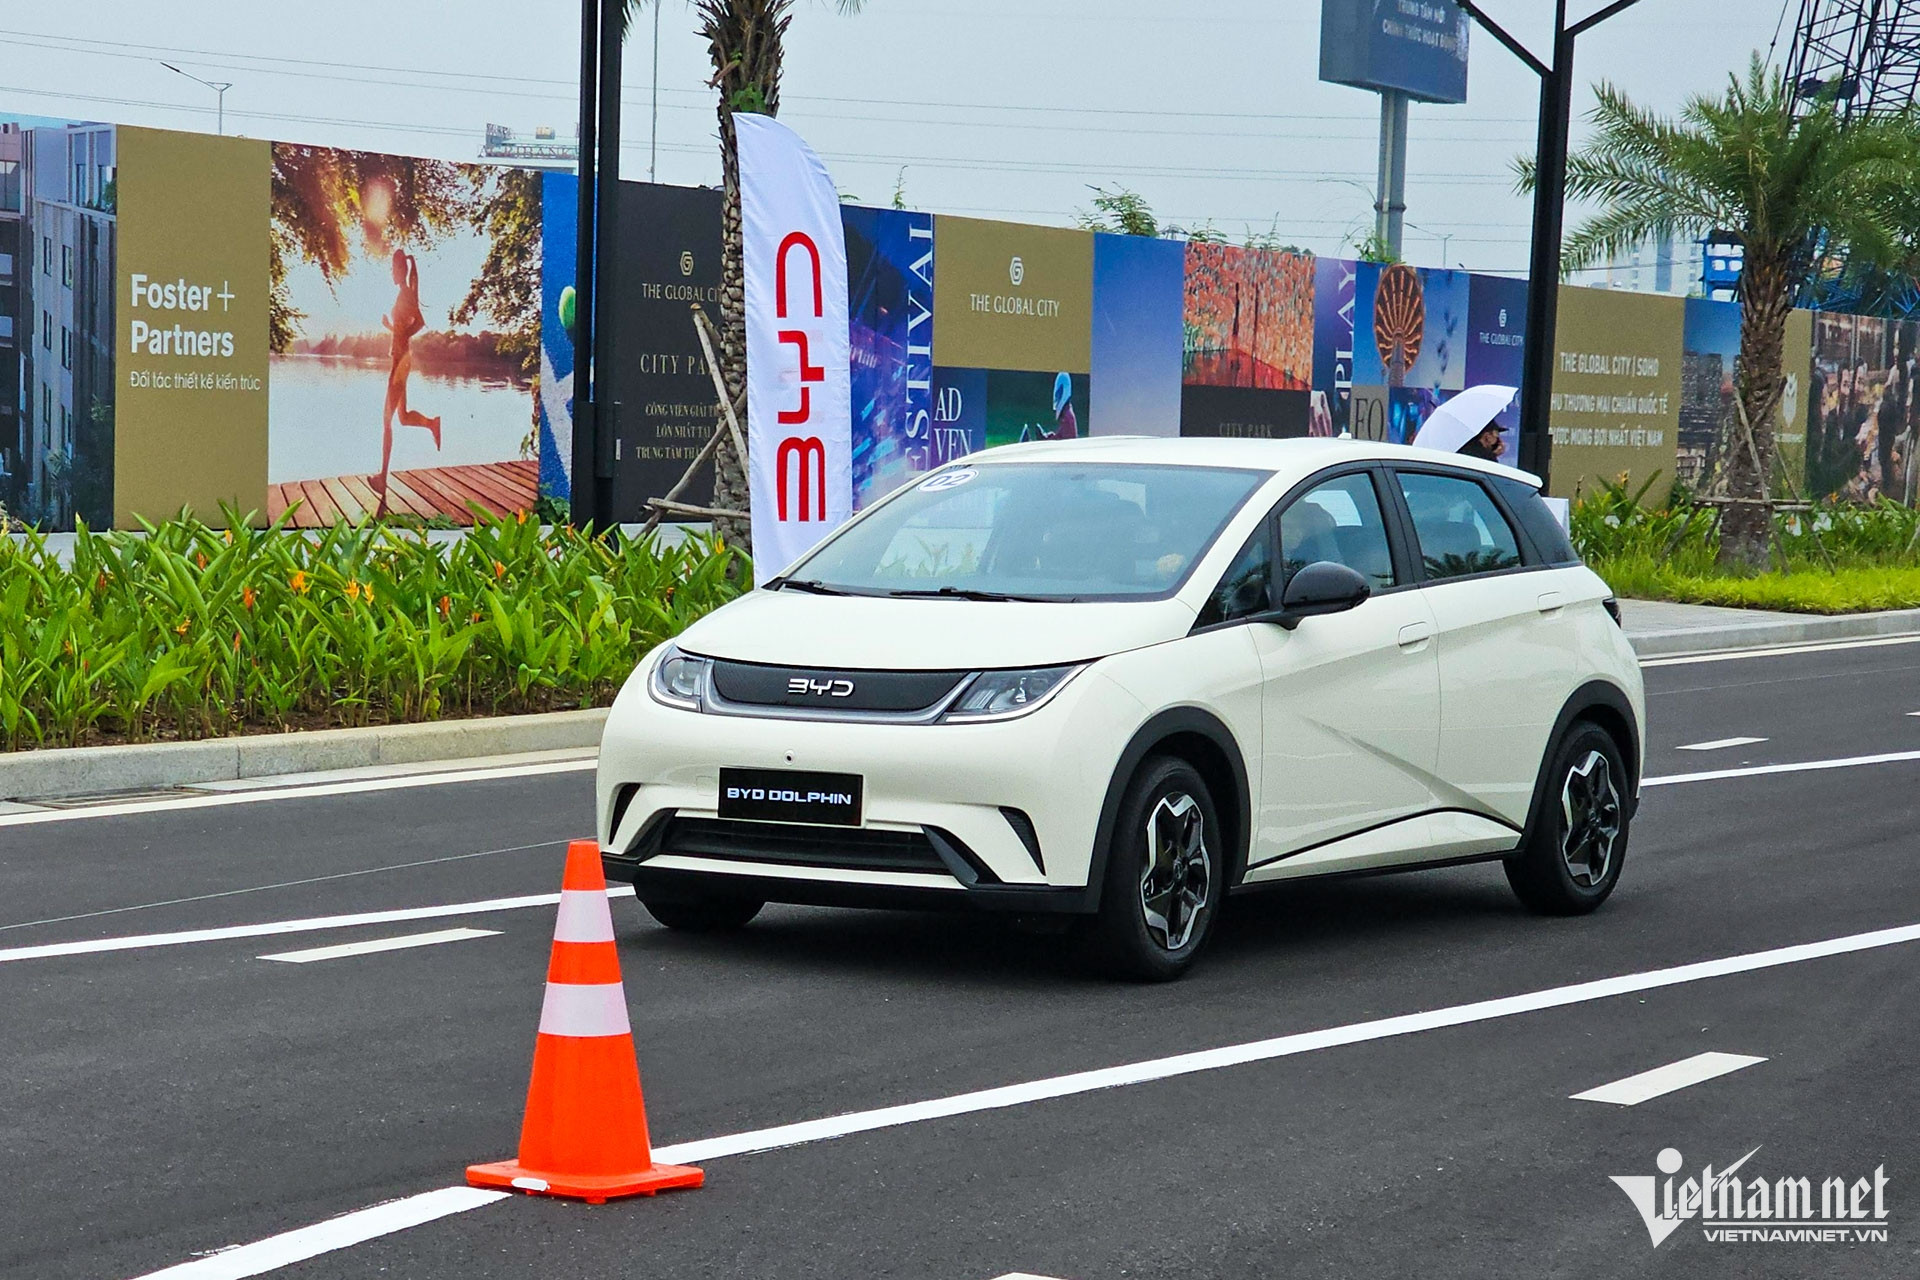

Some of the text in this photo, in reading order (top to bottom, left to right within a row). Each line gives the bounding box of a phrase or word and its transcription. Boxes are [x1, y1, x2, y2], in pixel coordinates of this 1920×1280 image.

[131, 273, 212, 311] Foster
[642, 283, 661, 299] THE
[664, 284, 705, 302] GLOBAL
[970, 293, 1060, 317] THE GLOBAL CITY
[131, 320, 234, 357] Partners
[640, 353, 680, 375] CITY
[1560, 352, 1577, 373] THE
[1578, 354, 1610, 374] GLOBAL
[1612, 355, 1631, 375] CITY
[1637, 357, 1659, 376] SOHO
[130, 369, 261, 391] Đối tác thiết kế kiến trúc
[776, 231, 826, 522] BYD
[933, 387, 962, 423] AD
[1551, 393, 1563, 412] HU
[788, 678, 854, 697] BYD
[727, 787, 852, 805] BYD DOLPHIN
